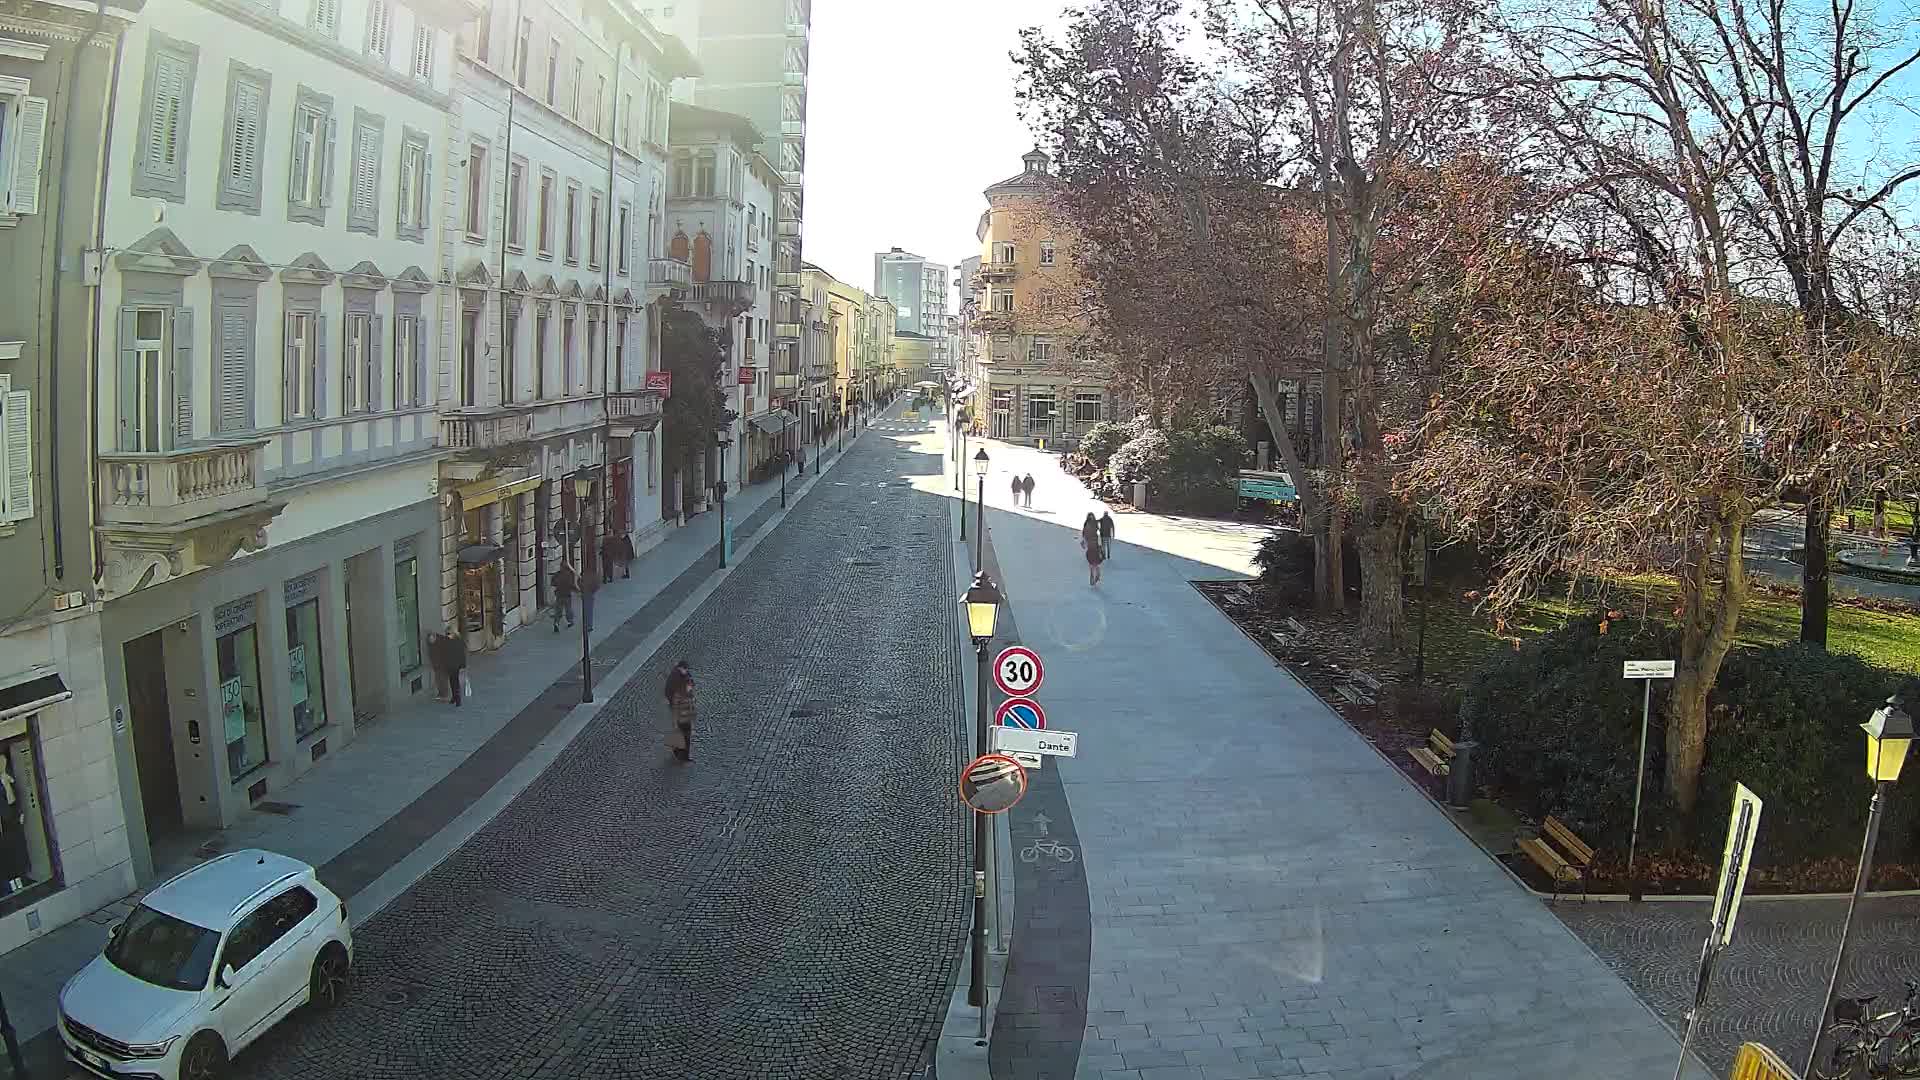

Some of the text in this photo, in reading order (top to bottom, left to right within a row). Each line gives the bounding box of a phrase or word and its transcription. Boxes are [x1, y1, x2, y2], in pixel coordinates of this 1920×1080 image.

[1006, 661, 1032, 683] 30
[223, 680, 240, 703] 130
[1038, 740, 1070, 752] Dante
